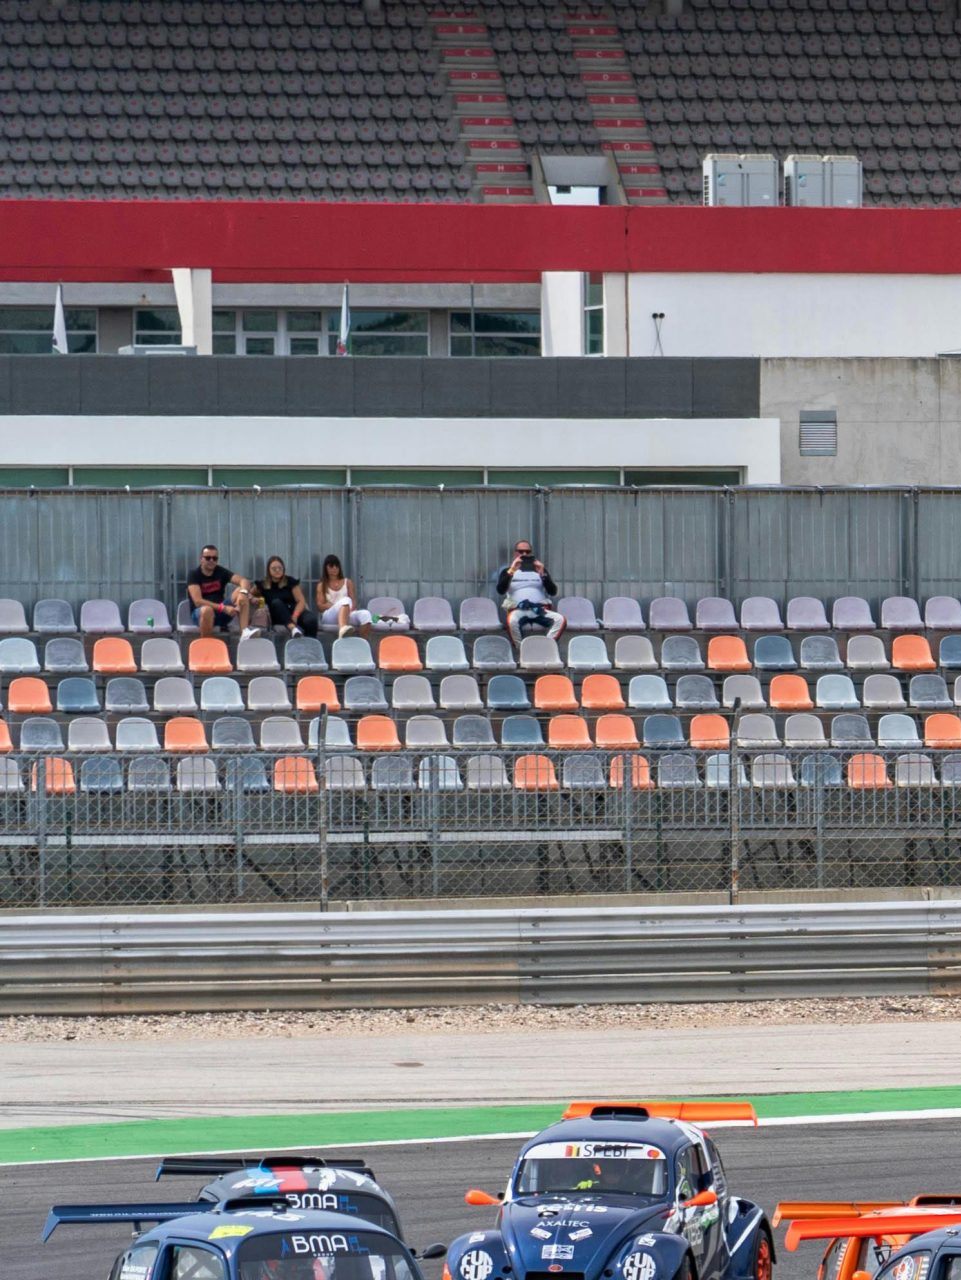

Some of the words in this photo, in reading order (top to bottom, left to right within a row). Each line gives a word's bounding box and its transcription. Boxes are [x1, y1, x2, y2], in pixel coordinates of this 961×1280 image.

[285, 1194, 338, 1209] BMA
[291, 1236, 349, 1253] BMA
[461, 1250, 493, 1267] FUN
[623, 1252, 656, 1269] FUN
